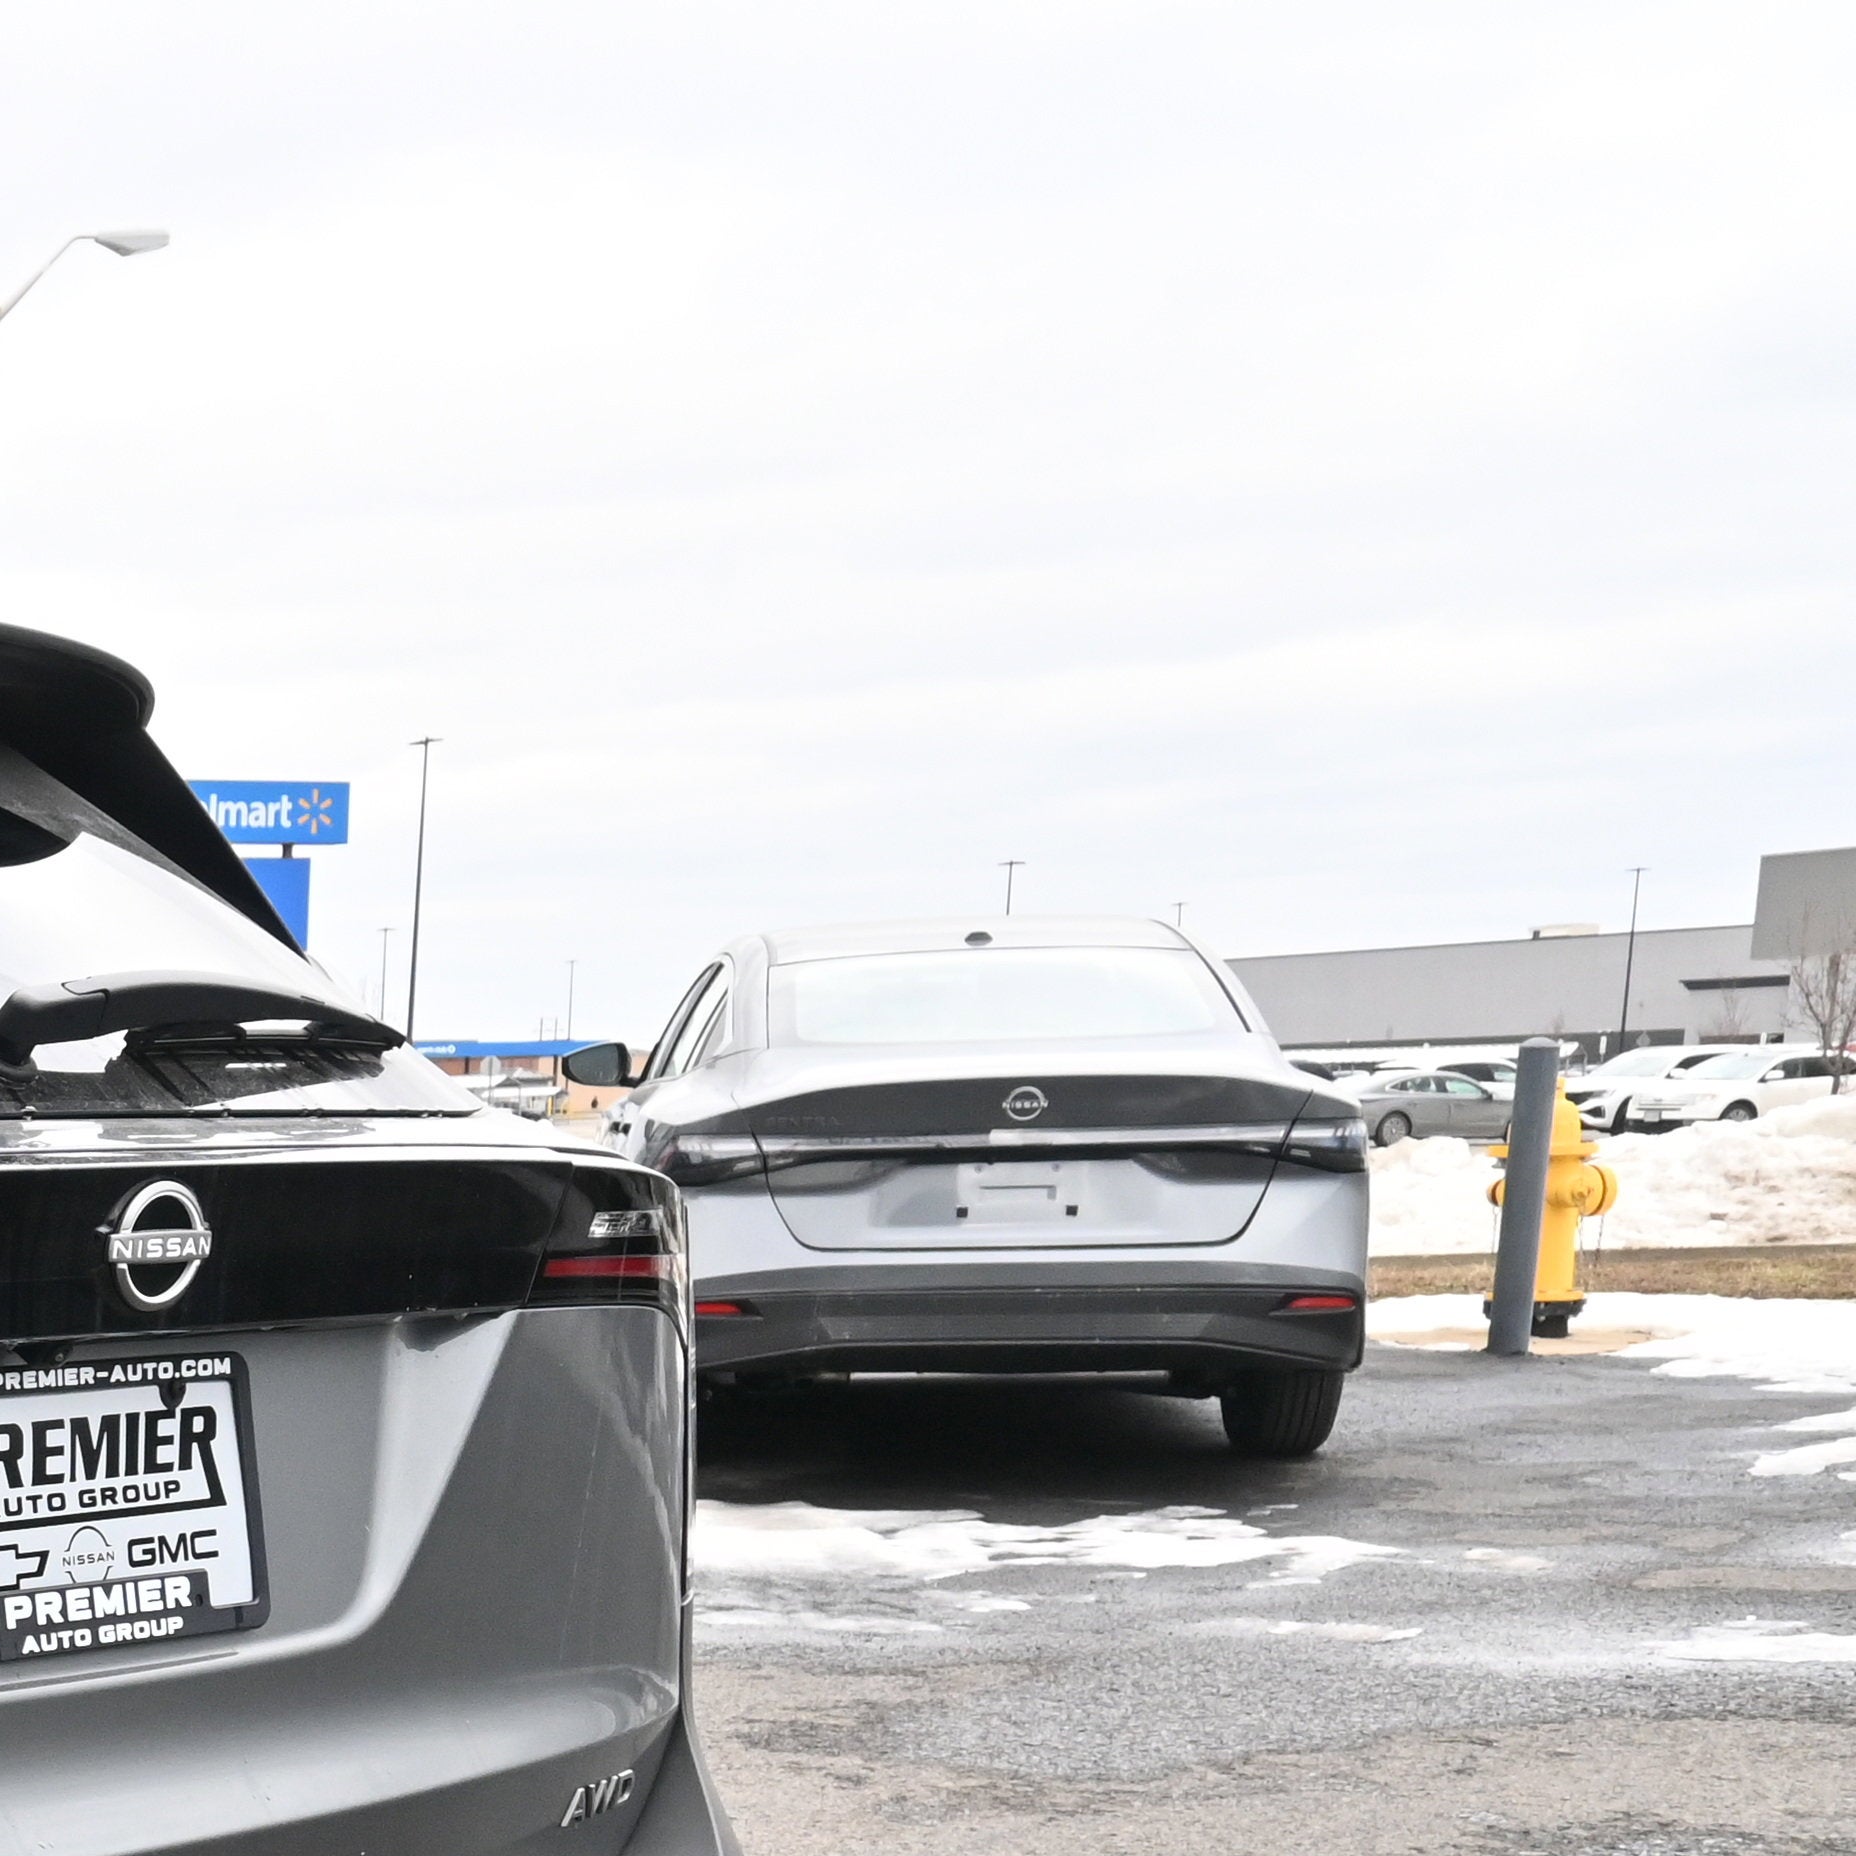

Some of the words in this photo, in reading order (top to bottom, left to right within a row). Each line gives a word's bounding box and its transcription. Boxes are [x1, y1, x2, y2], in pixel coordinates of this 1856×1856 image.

[110, 1235, 212, 1261] NISSAN
[78, 1480, 181, 1508] GROUP
[62, 1551, 115, 1567] NISSAN
[127, 1529, 219, 1568] GMC
[4, 1576, 192, 1630] PREMIER
[21, 1627, 92, 1655] AUTO
[98, 1615, 184, 1644] GROUP
[560, 1768, 635, 1827] AWD
